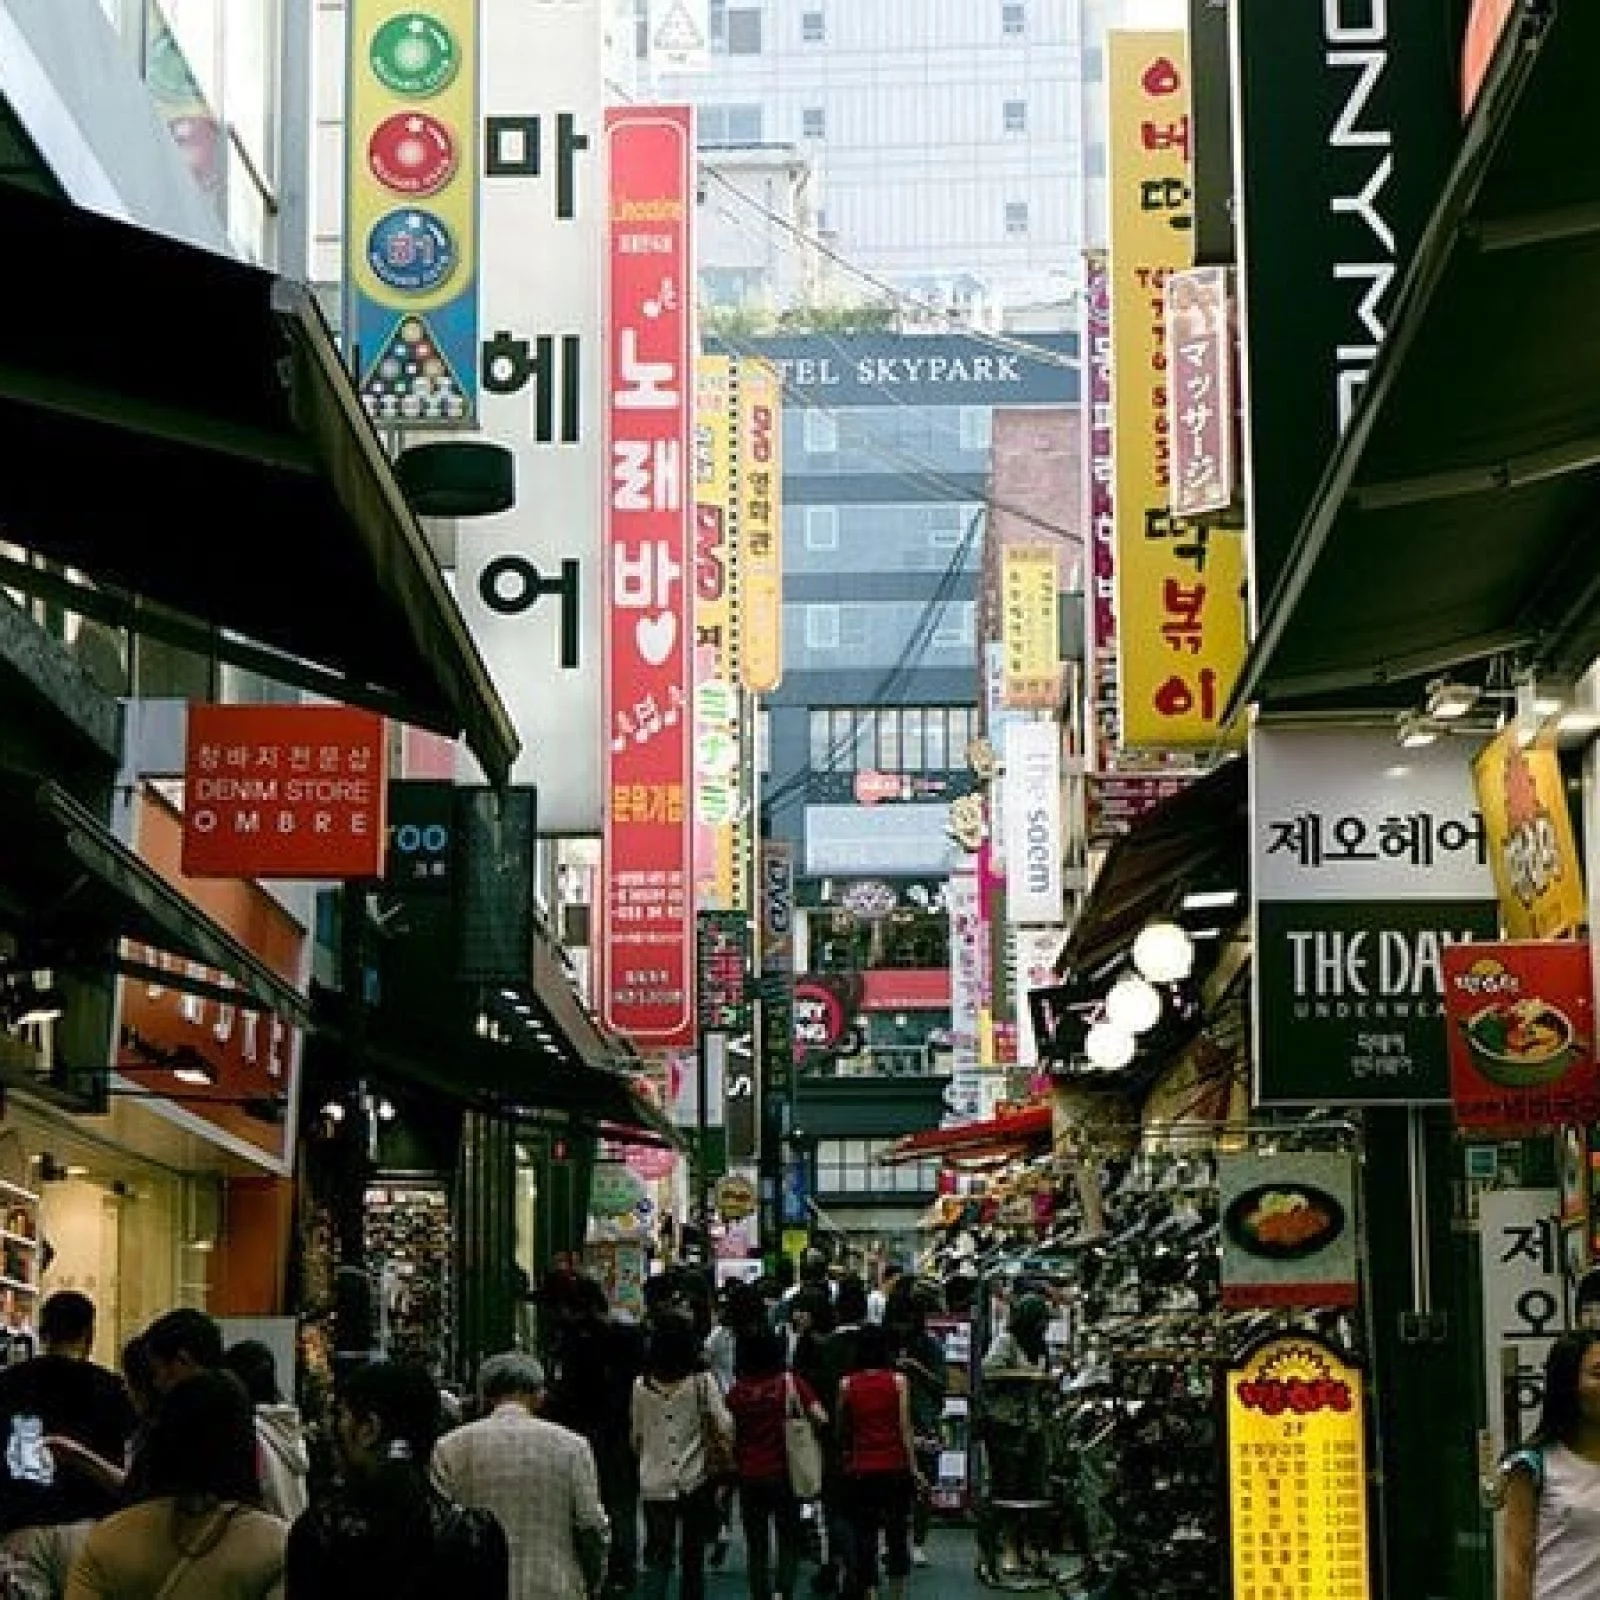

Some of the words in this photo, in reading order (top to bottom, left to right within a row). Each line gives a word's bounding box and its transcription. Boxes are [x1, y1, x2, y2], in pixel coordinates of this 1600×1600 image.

[481, 0, 590, 669] 마헤어
[856, 357, 1021, 385] SKYPARK
[753, 404, 771, 463] DVD
[1180, 340, 1213, 488] マッサージ
[613, 328, 682, 608] 노래방
[697, 504, 727, 601] DVD
[1144, 507, 1217, 722] 떡볶이
[193, 809, 368, 834] OMBRE
[200, 778, 278, 802] DENIM
[287, 778, 371, 802] STORE
[388, 824, 448, 852] OO
[1026, 810, 1051, 894] saem
[1266, 811, 1488, 868] 제오헤어
[1286, 930, 1369, 996] THE
[1378, 930, 1473, 996] DA
